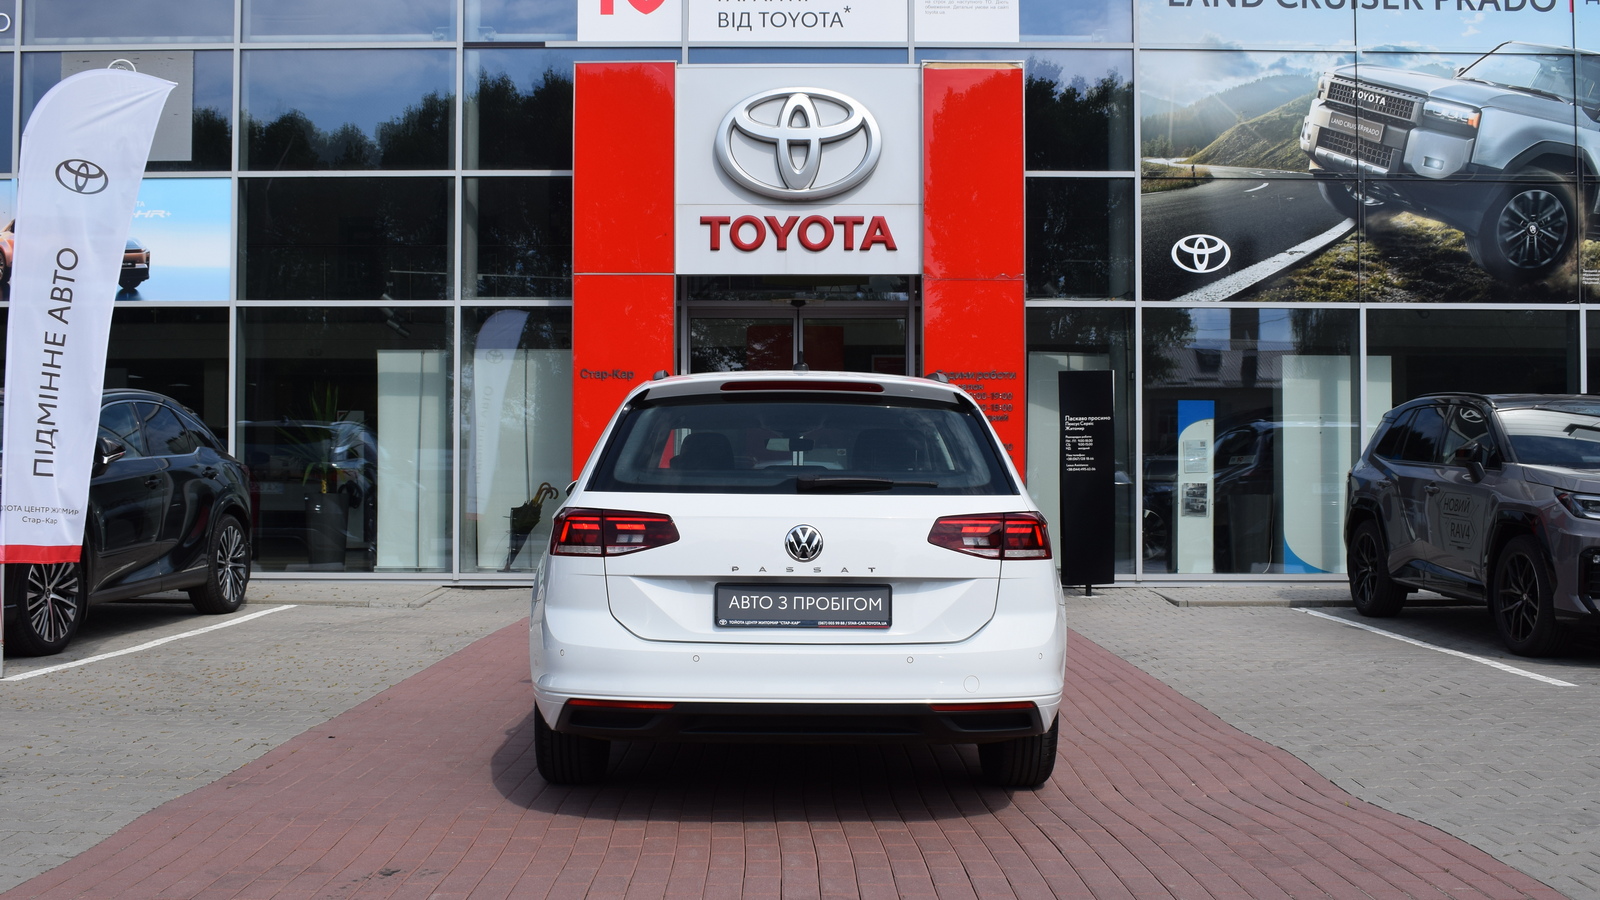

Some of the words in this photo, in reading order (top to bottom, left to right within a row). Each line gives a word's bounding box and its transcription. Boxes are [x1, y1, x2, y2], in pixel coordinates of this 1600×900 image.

[717, 11, 752, 31] ВІД
[1351, 90, 1386, 105] TOYOTA
[1330, 117, 1344, 126] LAND
[1343, 120, 1364, 132] CRUISER
[1363, 125, 1380, 136] PRADO
[699, 214, 898, 251] TOYOTA
[47, 247, 79, 325] АВТО
[580, 368, 635, 381] Стар-Кар
[976, 369, 1016, 381] роботи
[33, 331, 67, 478] ПІДМІННЕ
[24, 505, 50, 515] ЦЕНТР
[1443, 496, 1470, 513] НОВИЙ
[22, 515, 58, 525] Стар-Кар
[1450, 521, 1470, 540] RAV4
[731, 565, 876, 573] PASSAT
[728, 595, 773, 610] АВТО
[777, 595, 788, 610] З
[793, 596, 882, 611] ПРОБІГОМ
